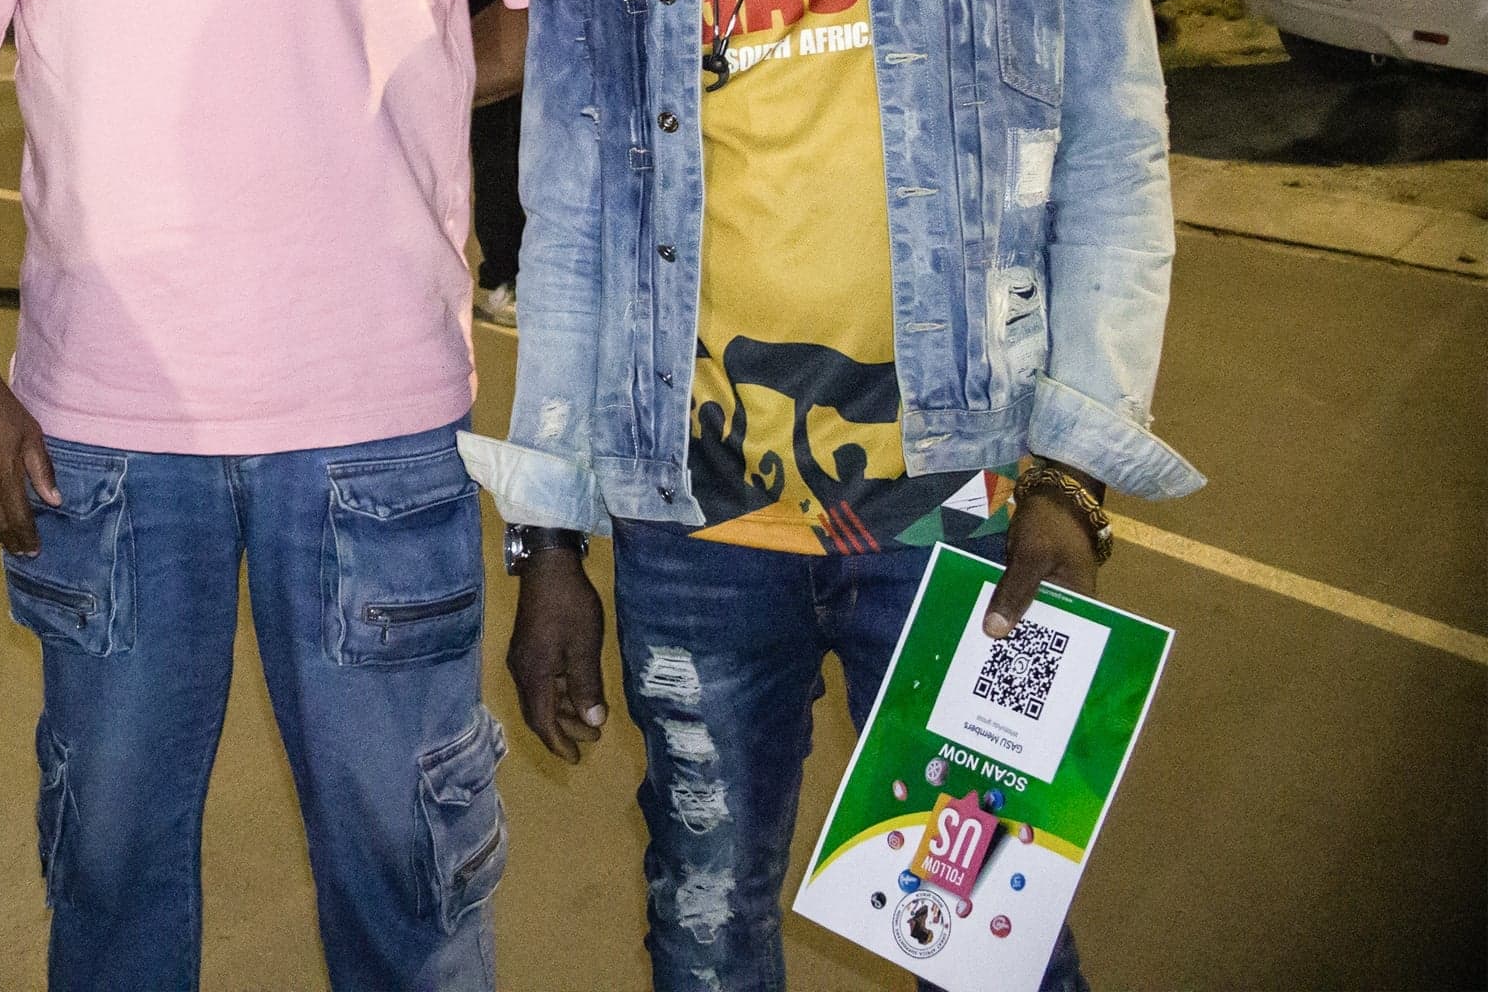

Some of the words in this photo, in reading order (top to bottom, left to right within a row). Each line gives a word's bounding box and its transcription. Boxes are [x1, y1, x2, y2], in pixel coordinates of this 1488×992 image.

[799, 22, 871, 56] AFRIC
[964, 721, 1000, 745] Members
[1000, 738, 1023, 754] GASU
[938, 743, 979, 771] NOW
[980, 761, 1028, 792] SCAN
[929, 807, 983, 869] US
[921, 855, 965, 886] FOLLOW
